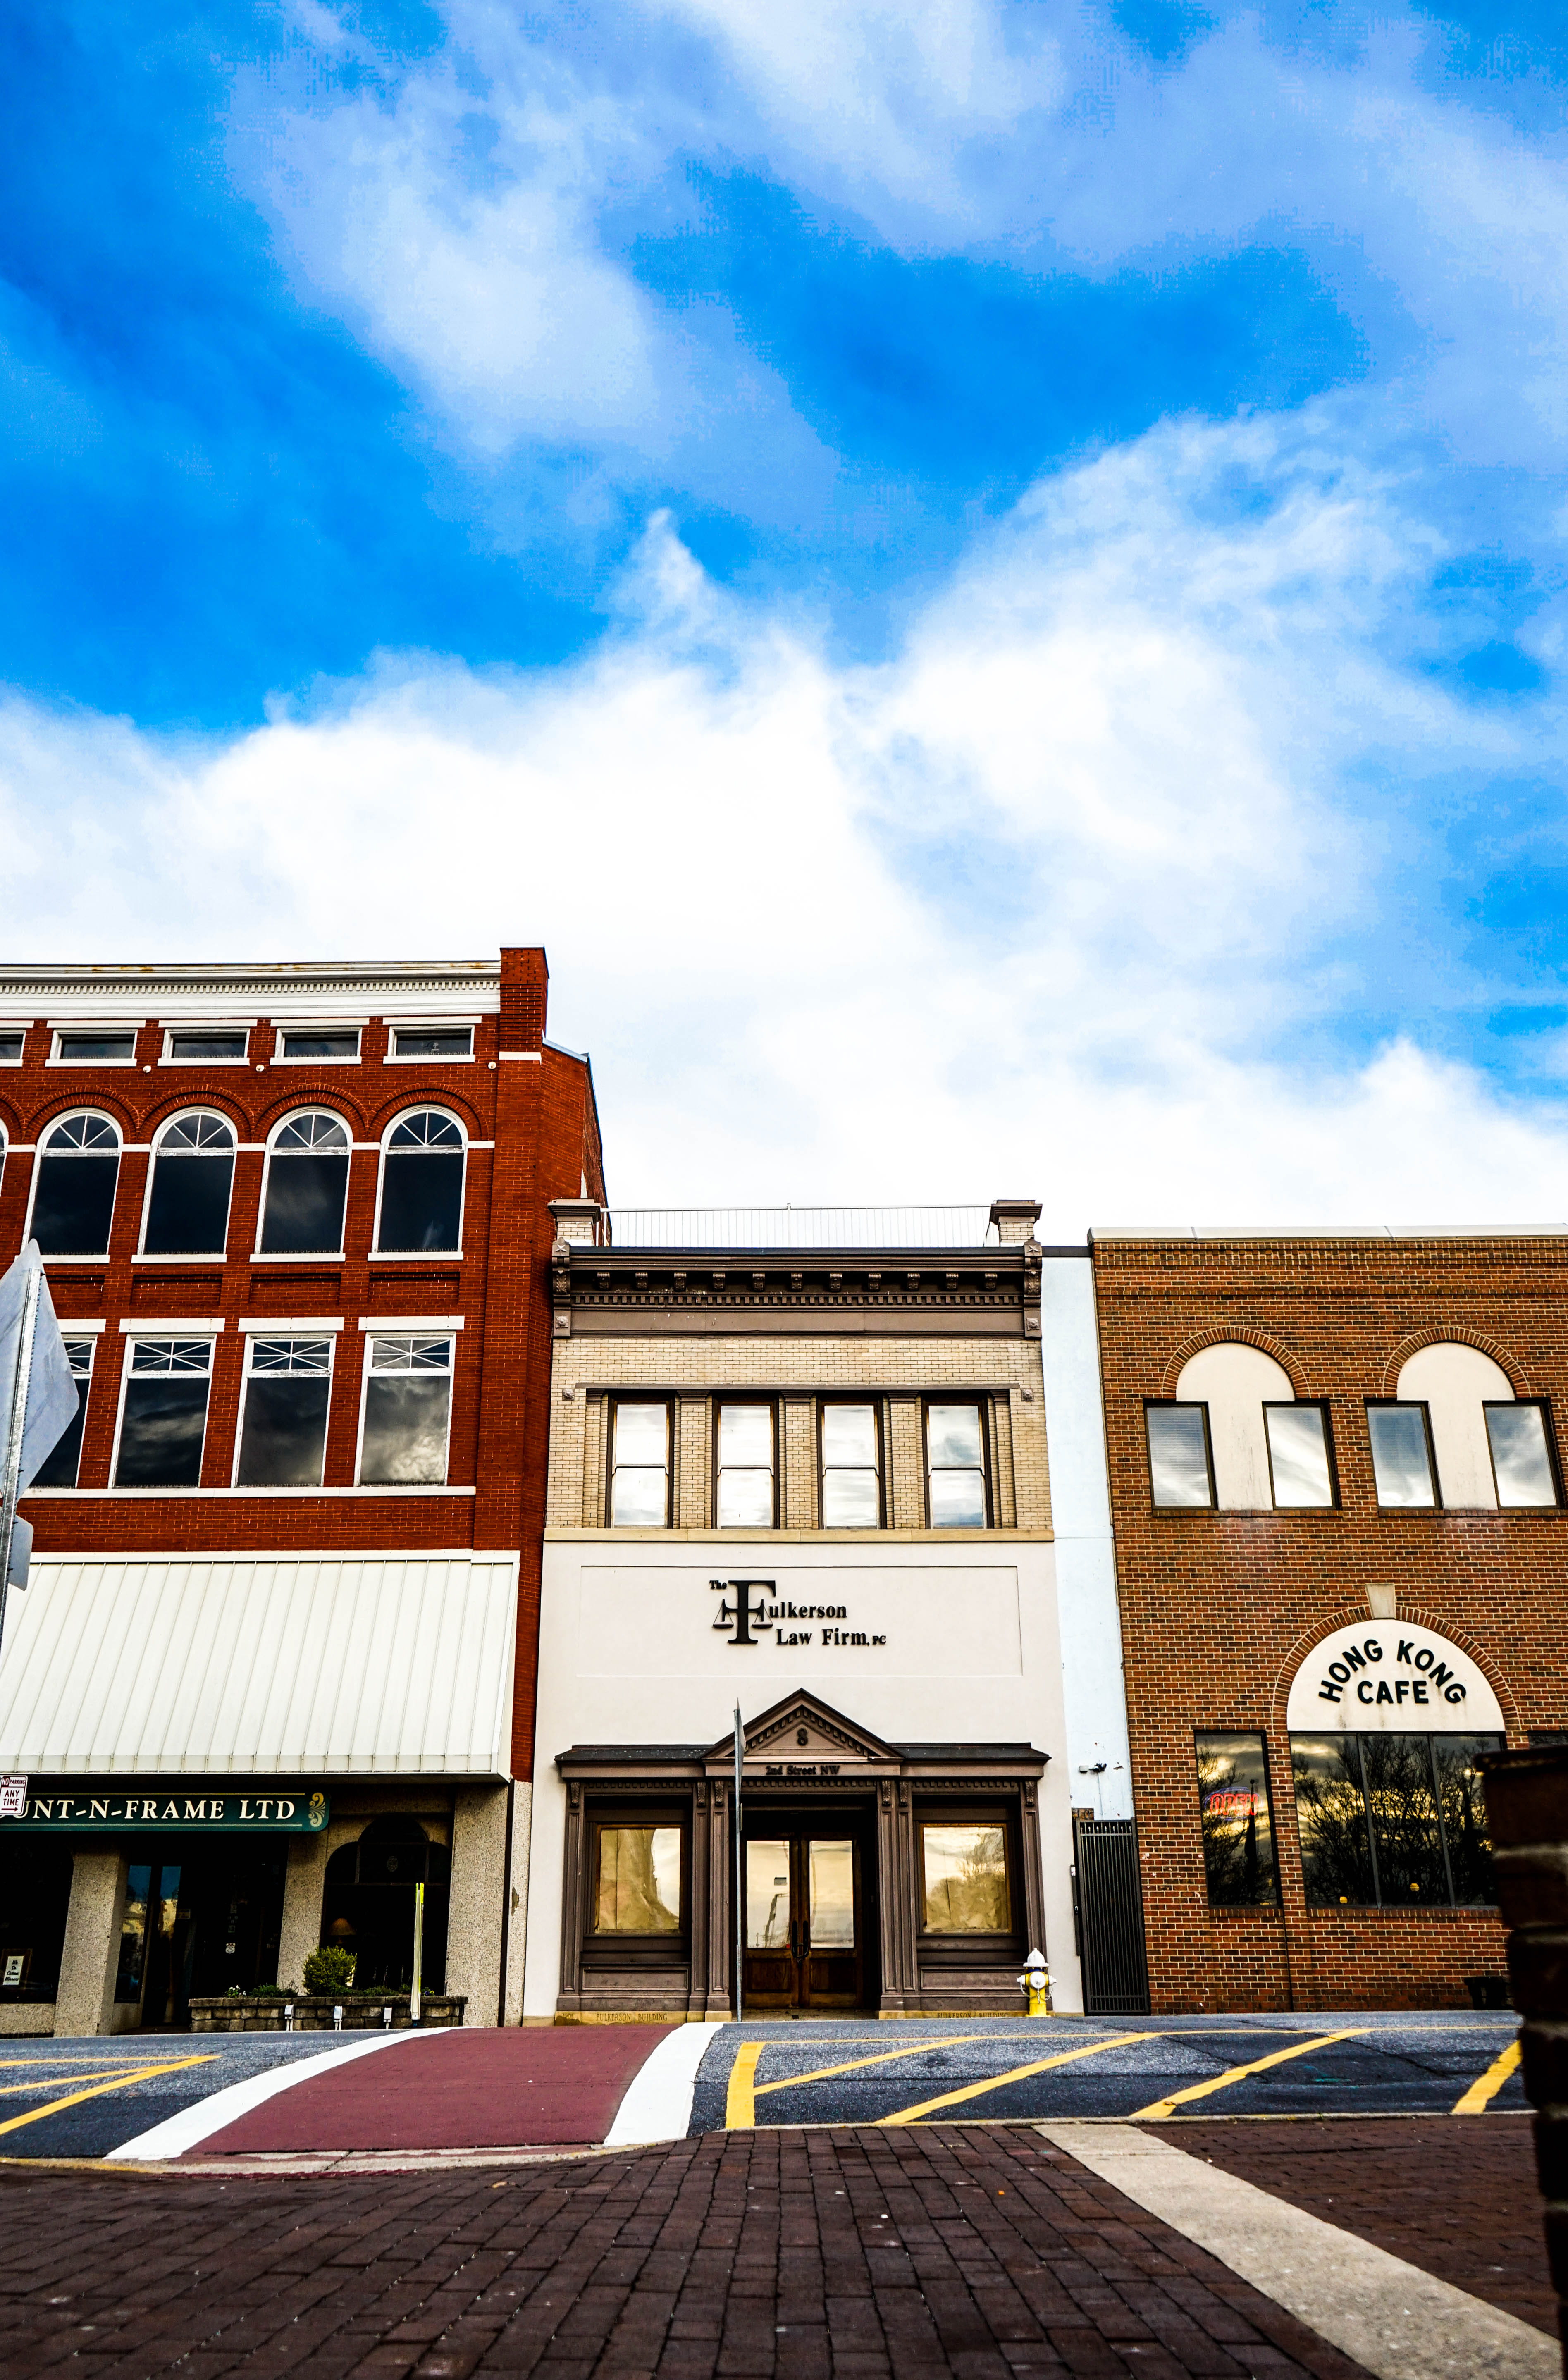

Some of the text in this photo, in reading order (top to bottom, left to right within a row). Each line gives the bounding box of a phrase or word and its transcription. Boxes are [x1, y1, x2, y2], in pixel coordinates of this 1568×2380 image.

[709, 1580, 727, 1589] The
[776, 1629, 812, 1645] Law
[872, 1635, 886, 1644] PC
[1318, 1639, 1466, 1703] HONG KONG
[1358, 1681, 1429, 1704] CAFE
[766, 1765, 840, 1775] 2nd Street NW
[239, 1800, 295, 1819] LTD
[1210, 1793, 1258, 1815] OPEN
